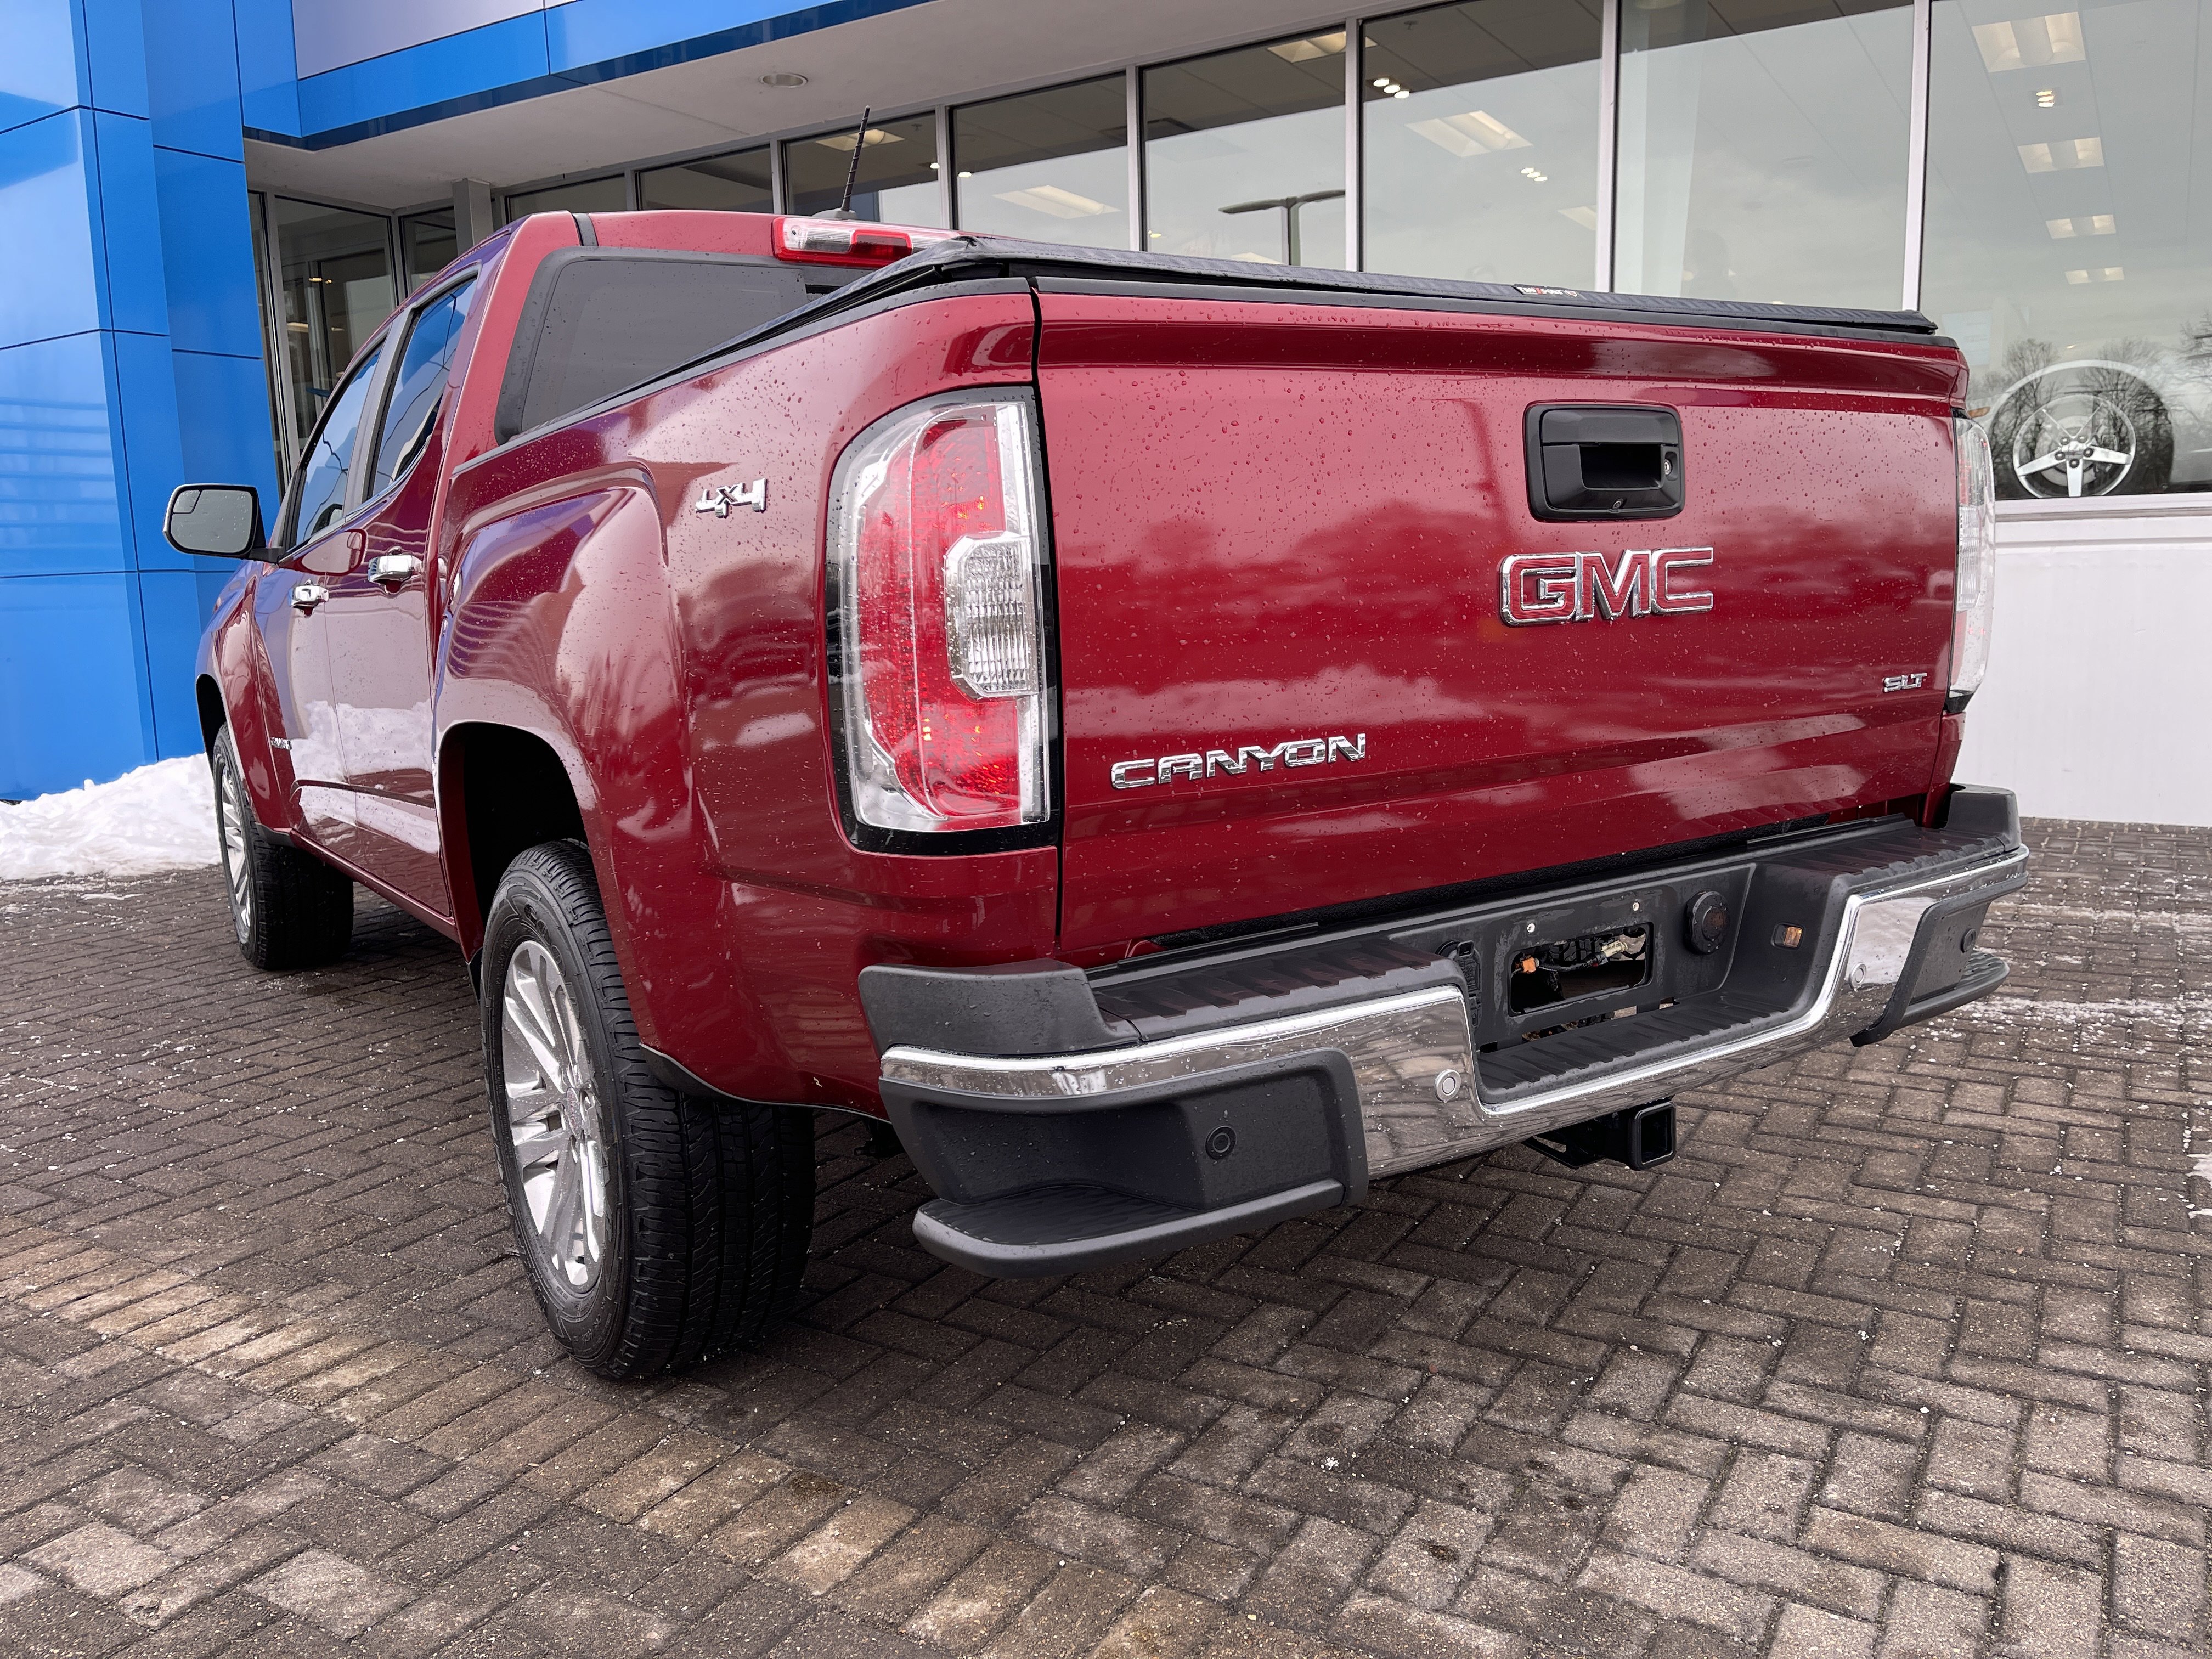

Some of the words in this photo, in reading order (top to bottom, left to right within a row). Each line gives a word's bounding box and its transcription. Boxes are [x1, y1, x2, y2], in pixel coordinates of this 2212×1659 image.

[1499, 546, 1714, 628] GMC
[1884, 672, 1927, 692] SLT
[1111, 733, 1366, 789] CANYON
